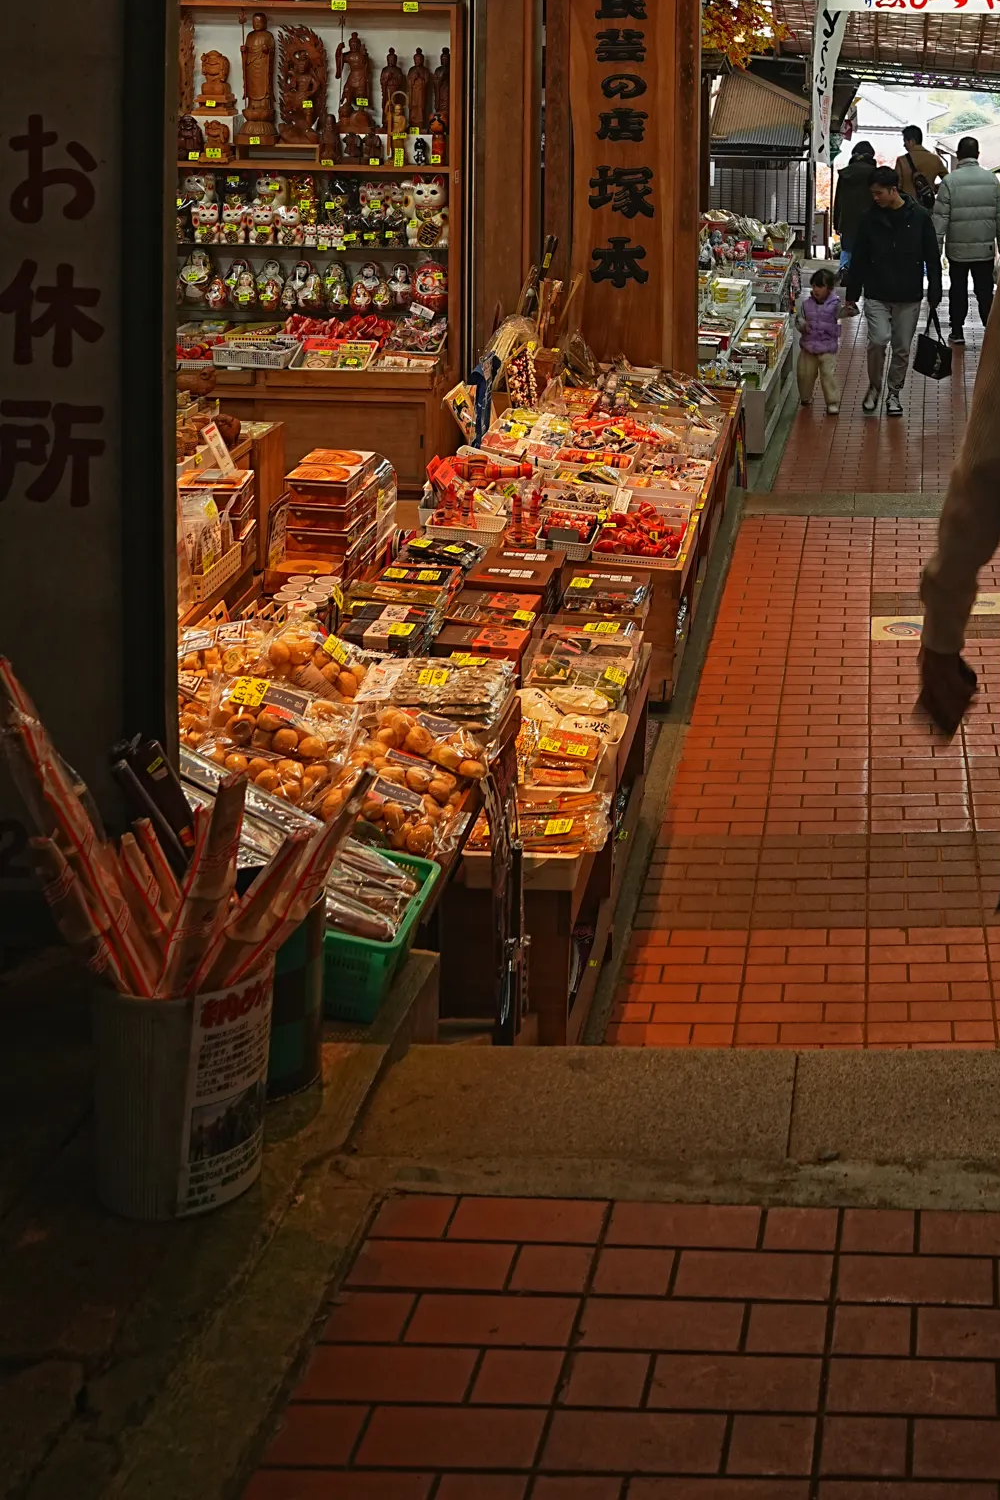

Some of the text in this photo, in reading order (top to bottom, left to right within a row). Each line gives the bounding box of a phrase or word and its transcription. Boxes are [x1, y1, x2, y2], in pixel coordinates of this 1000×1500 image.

[0, 112, 106, 508] お休所
[588, 165, 655, 289] 塚本
